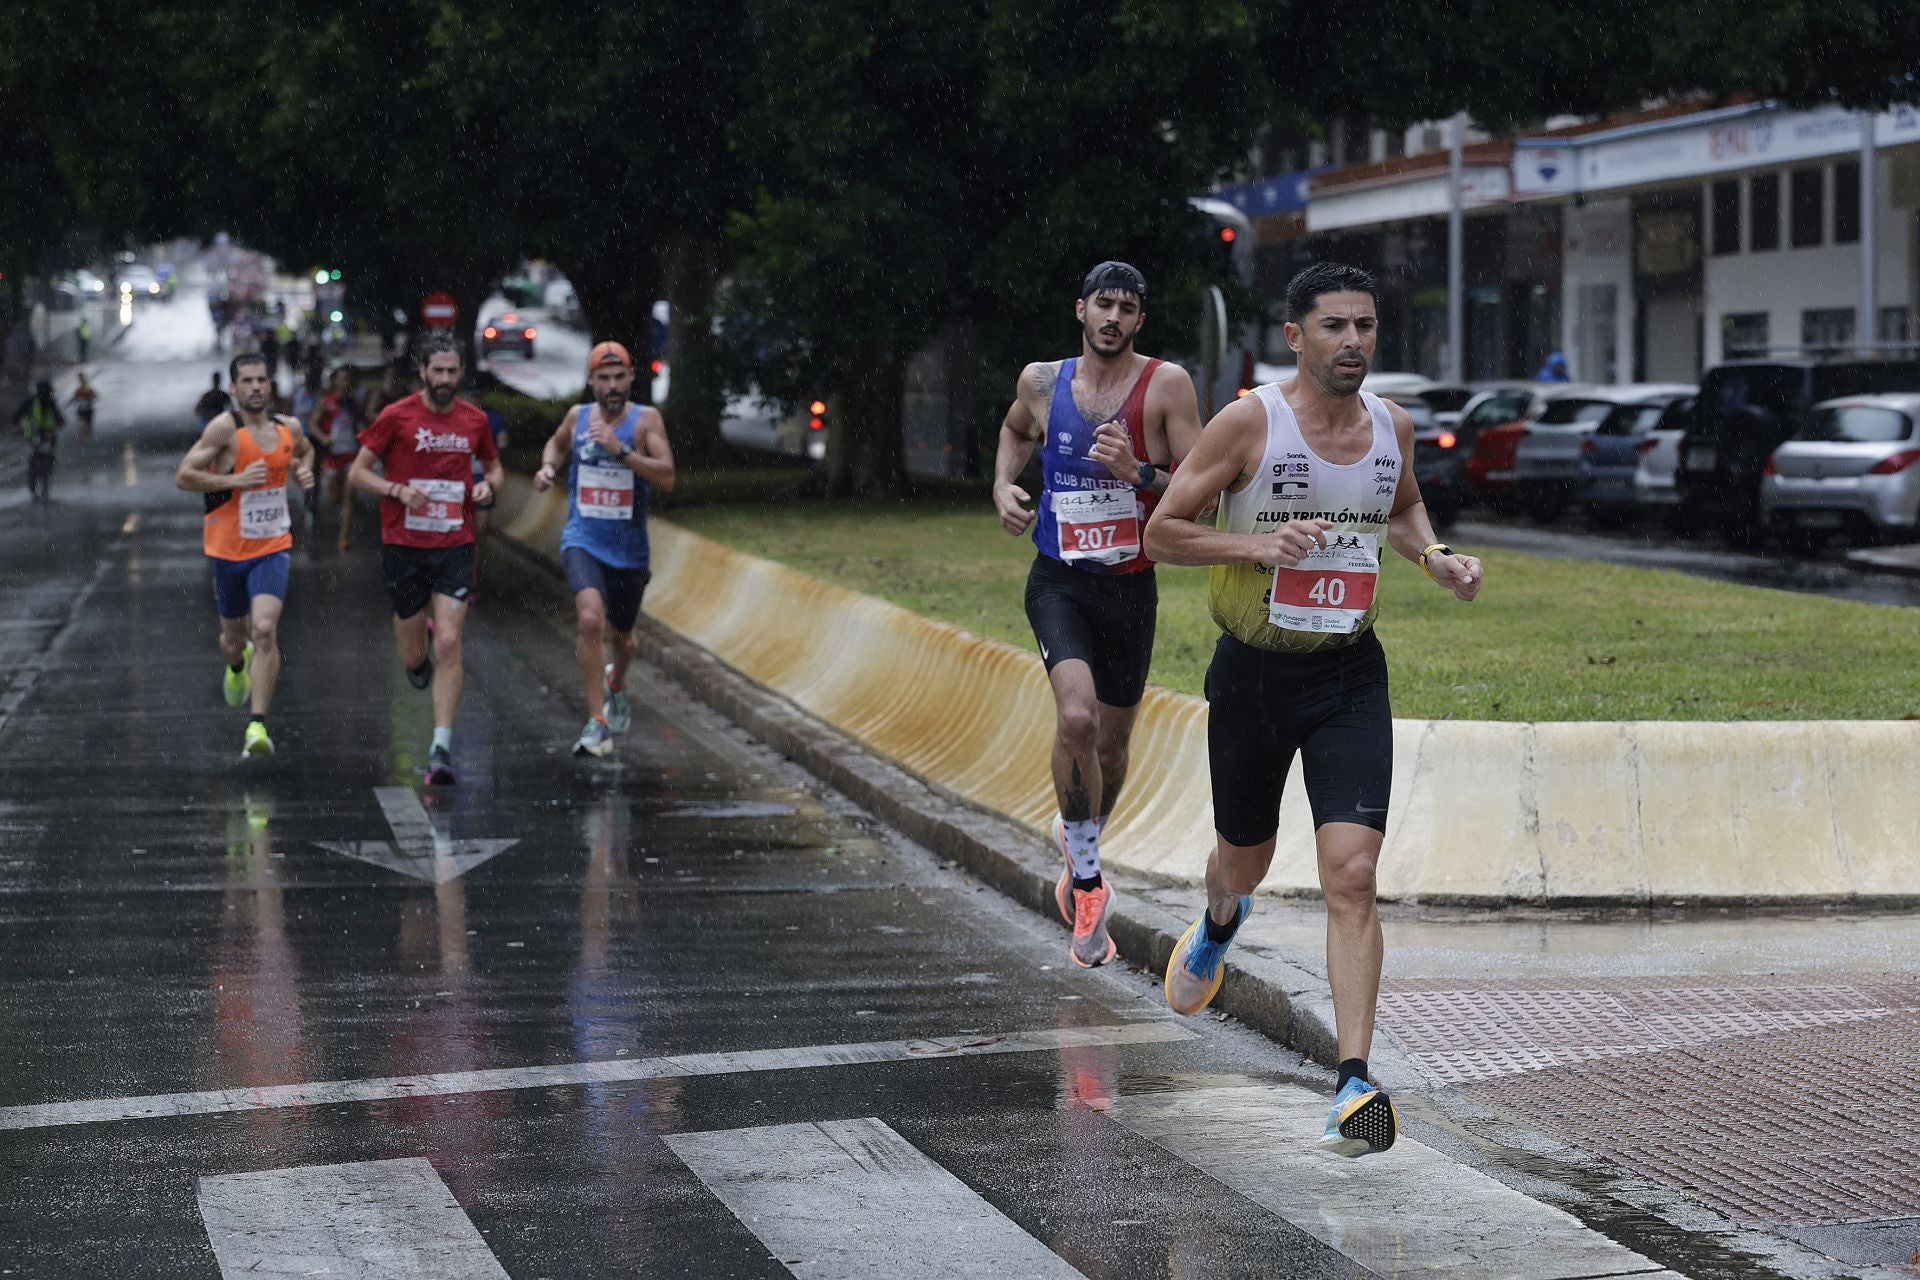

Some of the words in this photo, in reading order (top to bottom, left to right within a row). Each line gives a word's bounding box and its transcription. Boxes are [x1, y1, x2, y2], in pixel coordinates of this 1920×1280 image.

[1272, 463, 1309, 477] gross
[1054, 471, 1078, 487] CLUB
[591, 490, 621, 506] 115
[426, 502, 448, 518] 38
[1256, 511, 1290, 523] CLUB
[1292, 507, 1359, 524] TRIATLÓN
[1073, 525, 1117, 550] 207
[1308, 577, 1346, 606] 40
